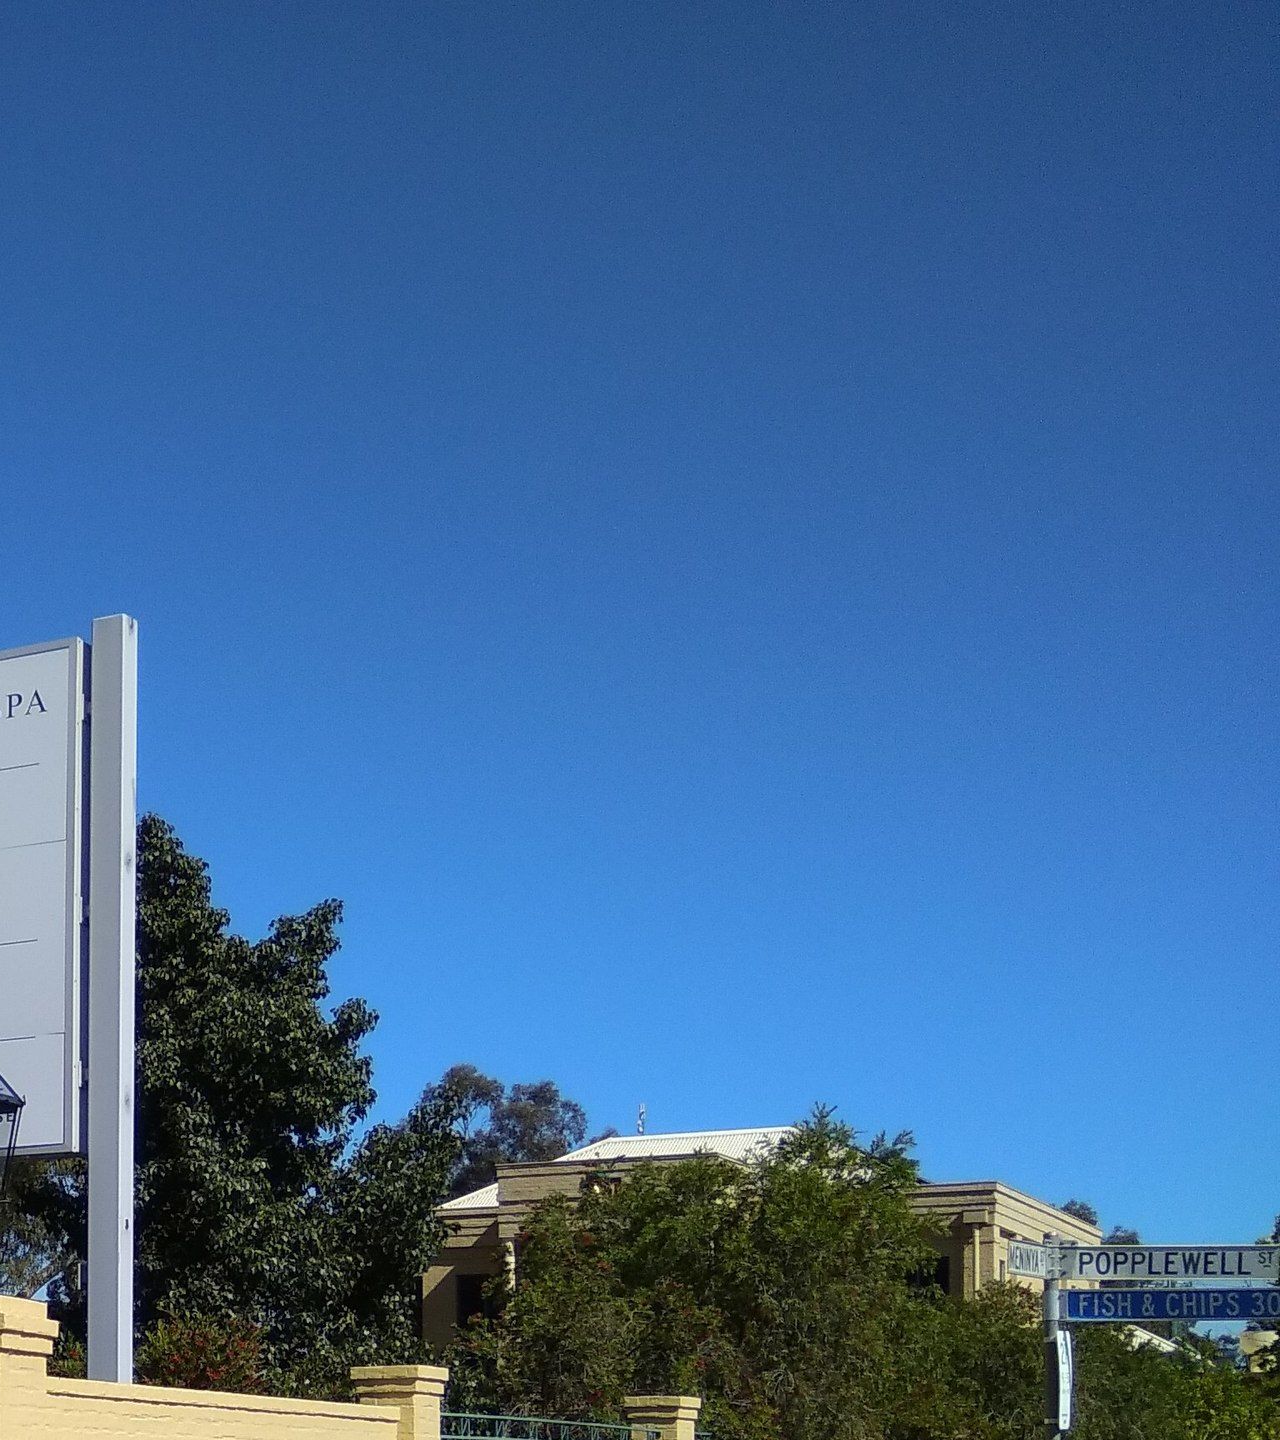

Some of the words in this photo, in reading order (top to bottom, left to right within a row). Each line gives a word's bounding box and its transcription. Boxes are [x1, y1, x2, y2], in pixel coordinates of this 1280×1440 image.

[1078, 1251, 1252, 1276] POPPLEWELL
[1258, 1251, 1274, 1267] ST
[1079, 1292, 1132, 1317] FISH
[1141, 1292, 1155, 1317] &
[1166, 1291, 1240, 1317] CHIPS
